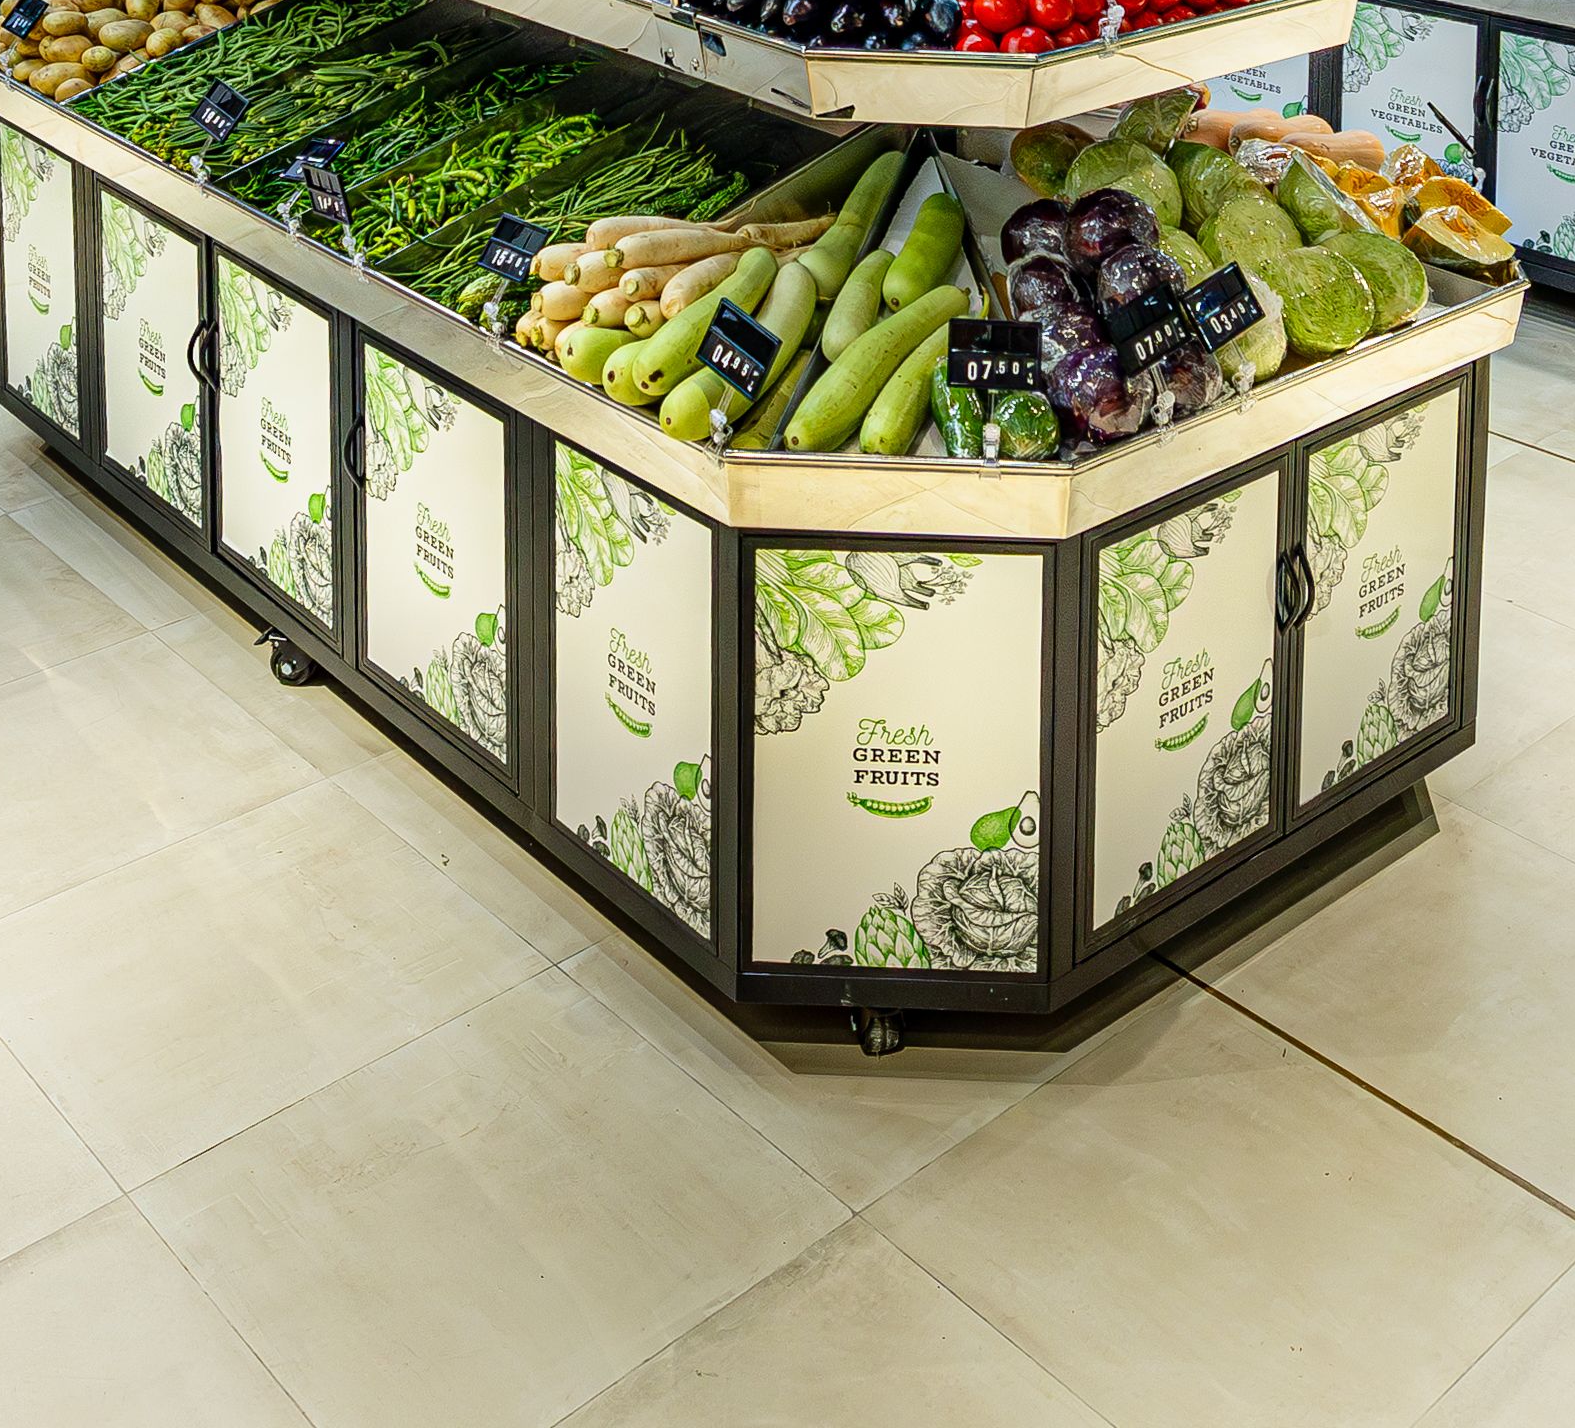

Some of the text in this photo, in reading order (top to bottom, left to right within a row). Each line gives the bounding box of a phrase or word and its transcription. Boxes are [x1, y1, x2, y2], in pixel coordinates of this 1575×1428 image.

[1387, 101, 1426, 118] GREEN
[1389, 86, 1423, 107] Fresh
[1370, 108, 1444, 135] VEGETABLES
[27, 262, 51, 285] GREEN
[139, 318, 164, 348] Fresh
[138, 338, 166, 363] GREEN
[139, 352, 166, 379] FRUITS
[711, 343, 749, 377] 04.95
[966, 360, 1021, 381] 07.50
[261, 397, 289, 432] Fresh
[260, 418, 292, 447] GREEN
[261, 434, 292, 465] FRUITS
[416, 502, 451, 542] Fresh
[415, 525, 455, 560] GREEN
[416, 544, 455, 580] FRUITS
[1361, 545, 1403, 582] Fresh
[1358, 564, 1406, 599] GREEN
[1358, 583, 1405, 619] FRUITS
[609, 627, 653, 674] Fresh
[607, 653, 657, 696] GREEN
[1161, 647, 1212, 690] Fresh
[608, 673, 657, 717] FRUITS
[1158, 668, 1215, 708] GREEN
[1158, 689, 1214, 729] FRUITS
[856, 717, 934, 747] Fresh
[852, 747, 942, 765] GREEN
[853, 769, 941, 787] FRUITS
